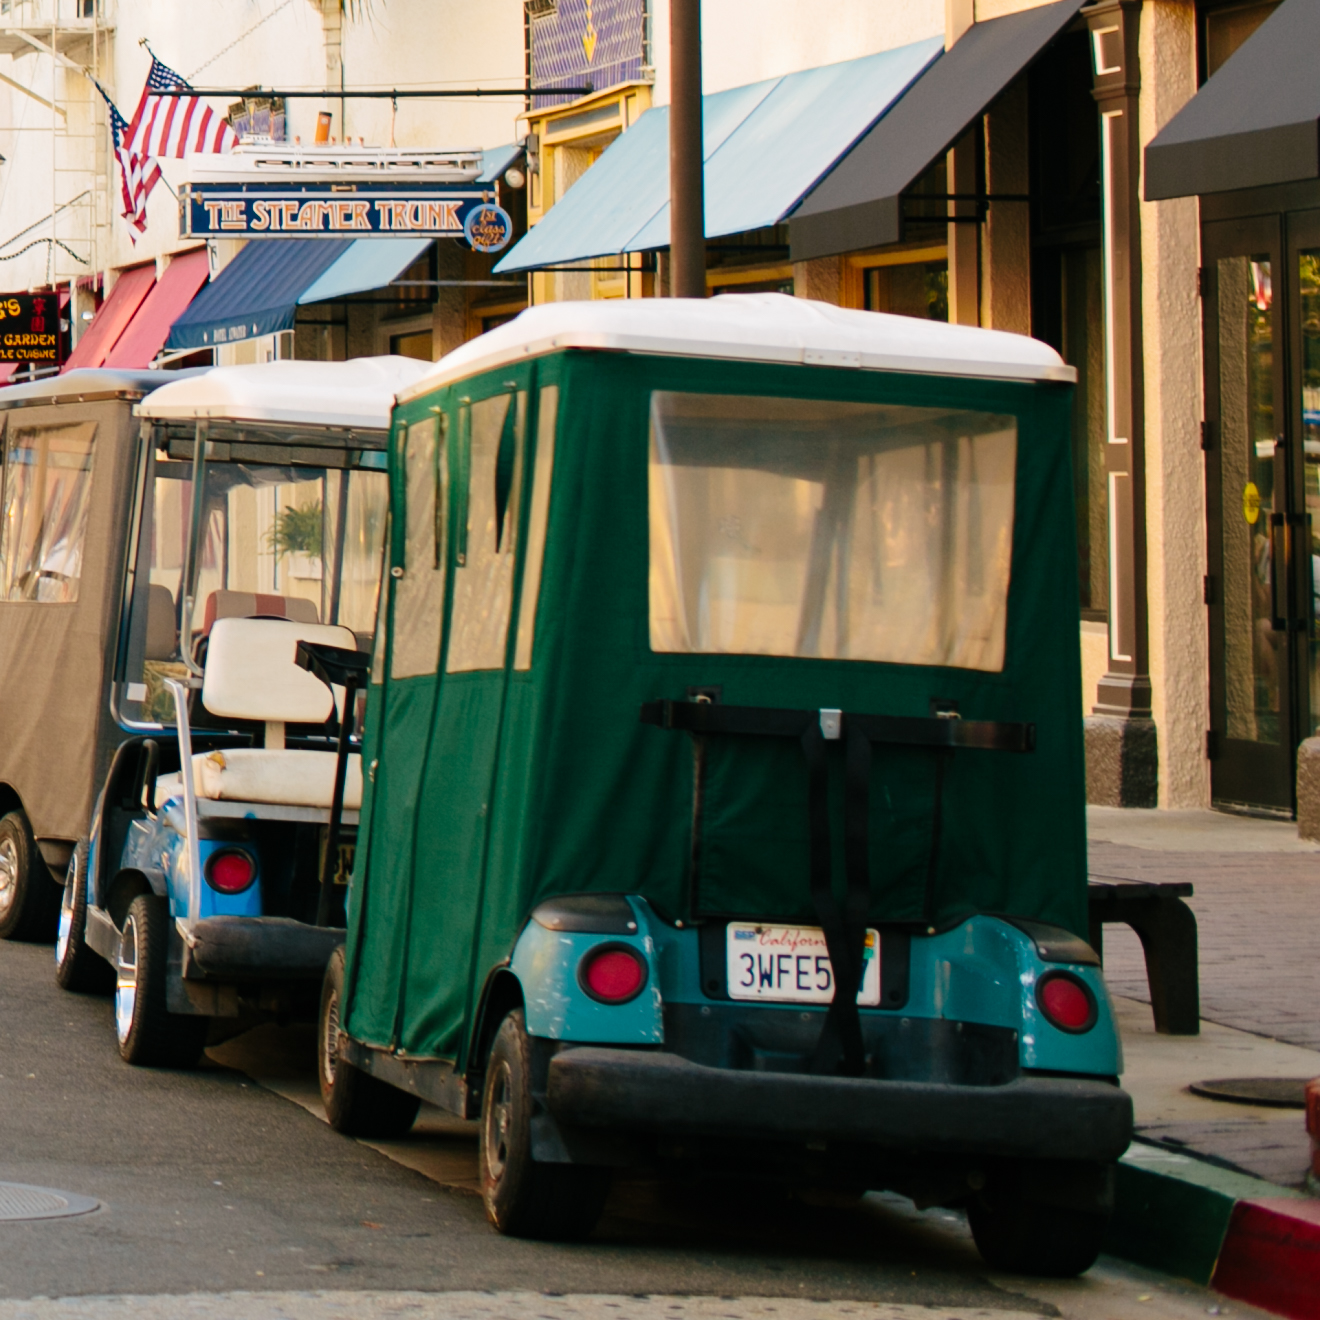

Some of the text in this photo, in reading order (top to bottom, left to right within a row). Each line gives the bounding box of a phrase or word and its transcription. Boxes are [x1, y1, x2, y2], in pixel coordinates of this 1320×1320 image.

[204, 200, 464, 230] THE STEAMER TRUNK
[3, 333, 57, 347] GARDEN
[15, 349, 57, 360] CUISINE
[760, 929, 827, 952] Californ
